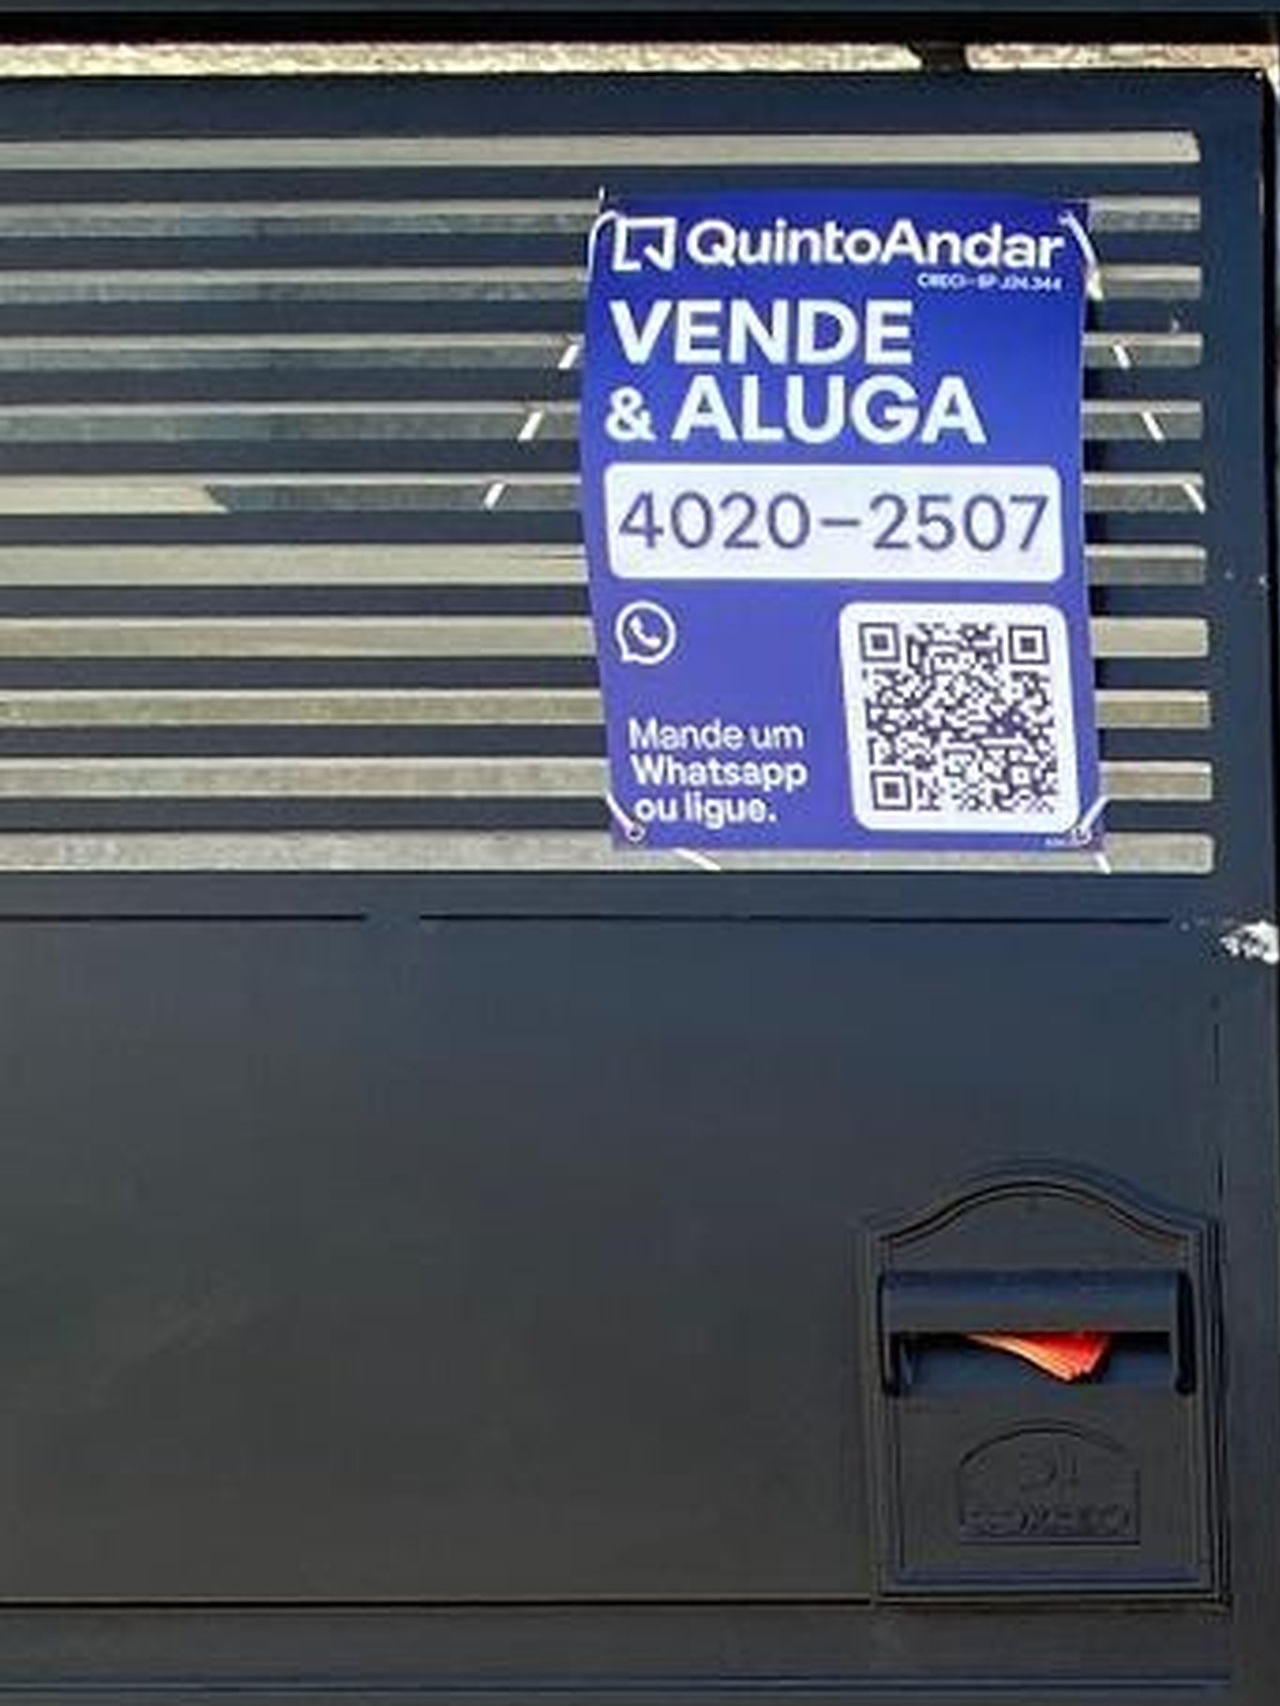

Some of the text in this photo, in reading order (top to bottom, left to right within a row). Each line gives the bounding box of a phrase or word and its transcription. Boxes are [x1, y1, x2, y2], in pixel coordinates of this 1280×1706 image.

[686, 217, 1065, 271] QuintoAndar
[608, 299, 914, 366] VENDE
[605, 374, 987, 445] & ALUGA
[618, 490, 1050, 554] 4020-2507
[628, 717, 804, 751] Mande um
[630, 754, 808, 792] Whatsapp
[634, 791, 777, 830] ou ligue.
